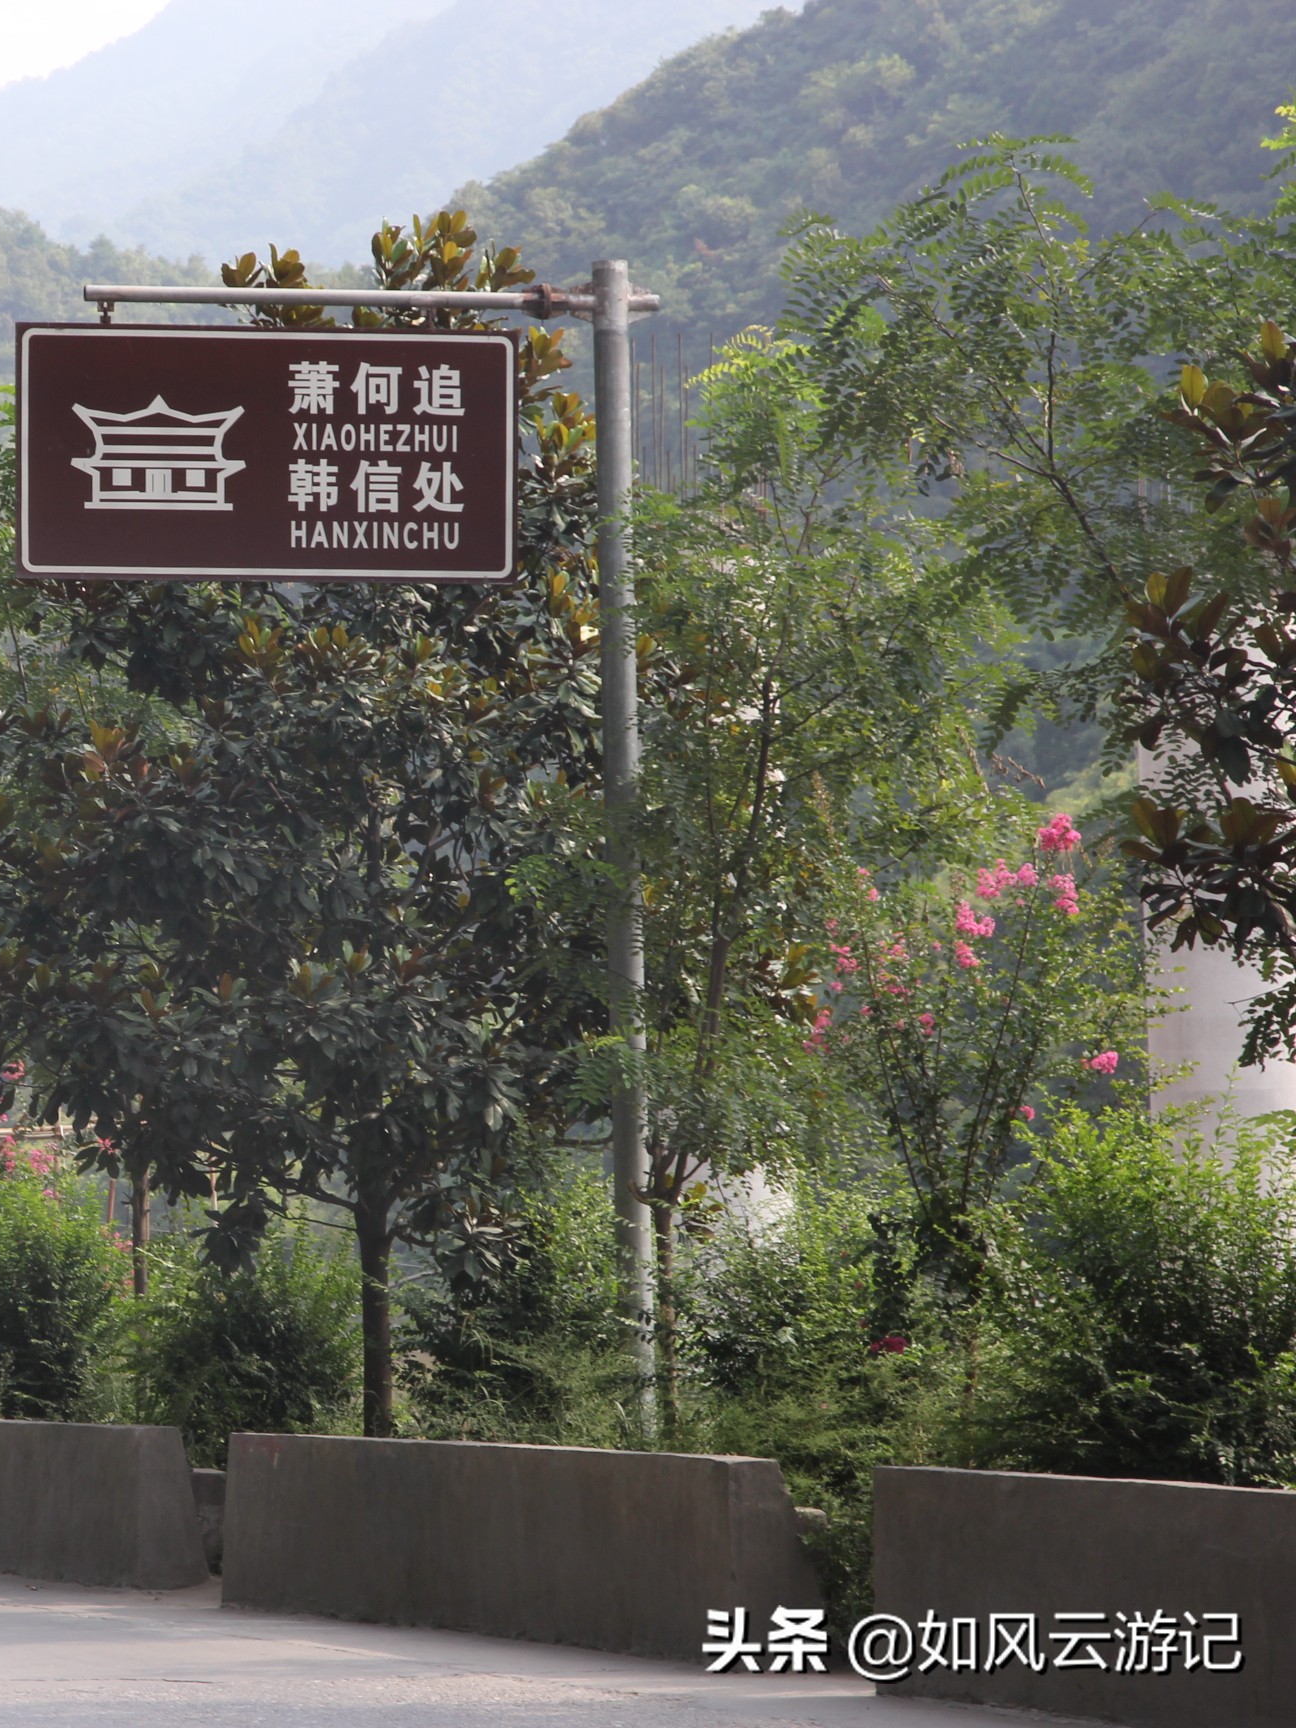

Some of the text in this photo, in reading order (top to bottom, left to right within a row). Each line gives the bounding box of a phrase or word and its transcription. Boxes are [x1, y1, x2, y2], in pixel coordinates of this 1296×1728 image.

[288, 361, 466, 416] 萧何追
[293, 422, 459, 453] XIAOHEZHUI
[288, 459, 465, 513] 韩信处
[290, 520, 460, 550] HANXINCHU
